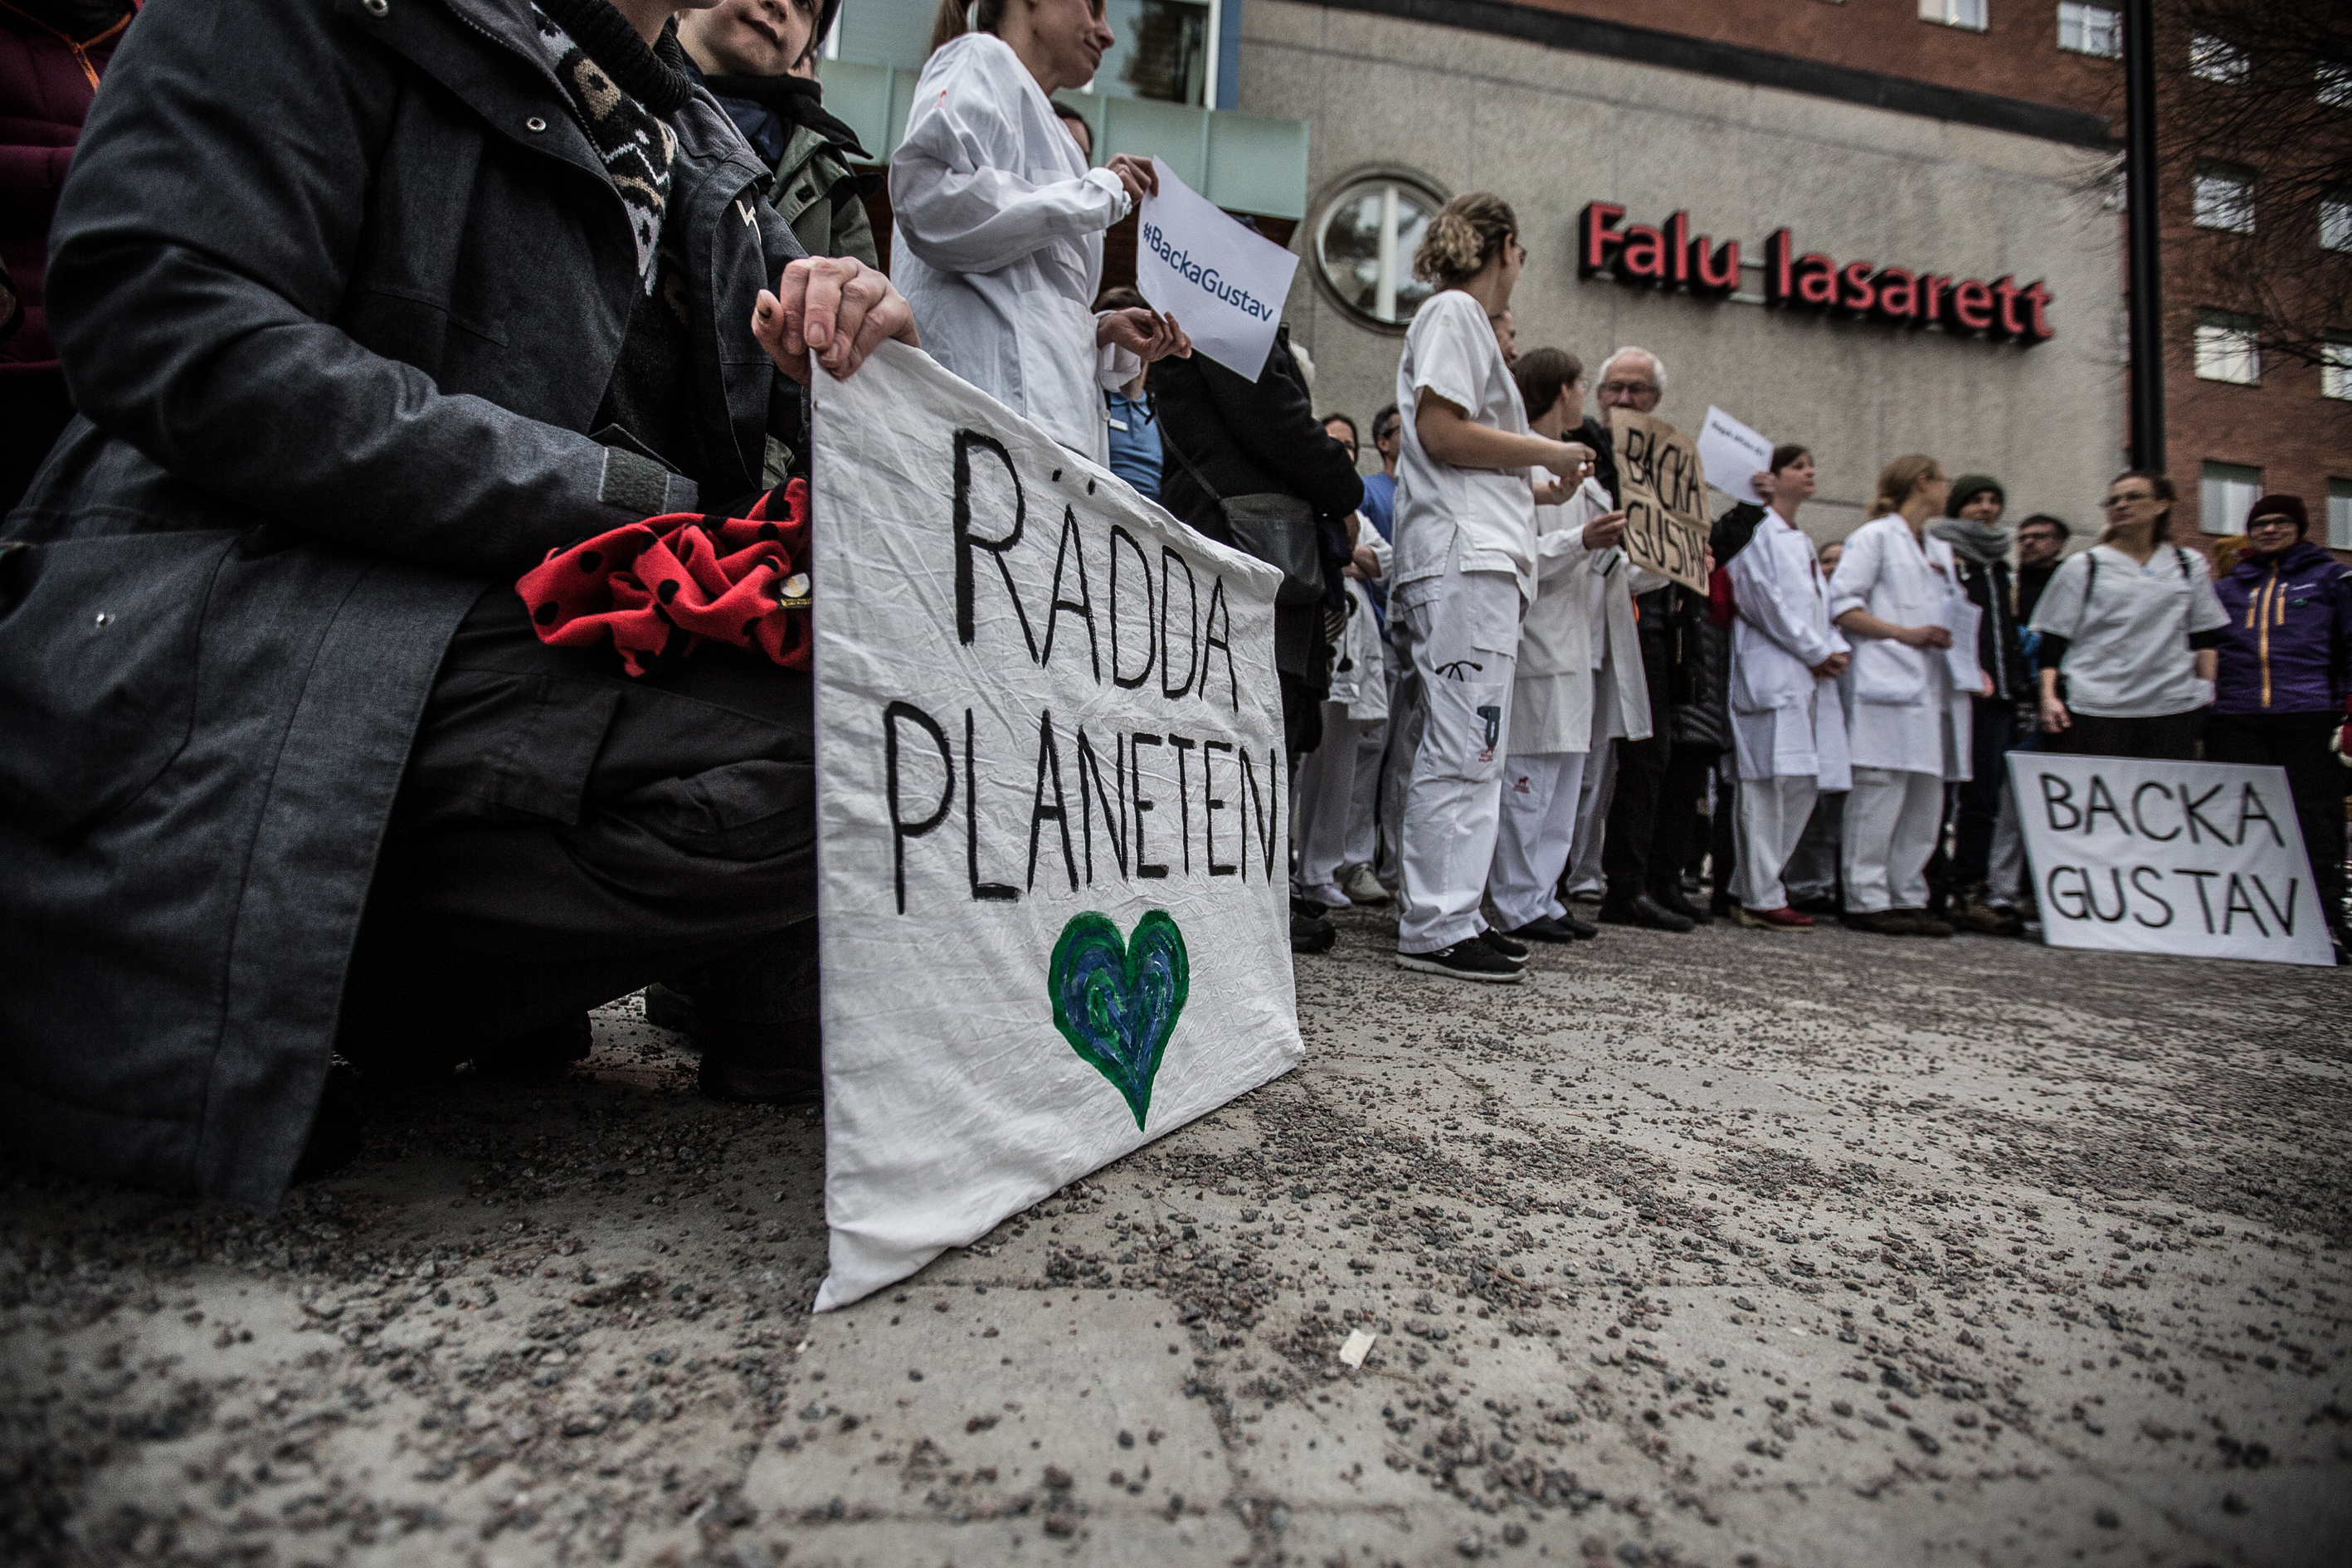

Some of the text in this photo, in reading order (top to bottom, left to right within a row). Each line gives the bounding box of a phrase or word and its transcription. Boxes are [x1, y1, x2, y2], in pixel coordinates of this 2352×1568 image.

[1143, 222, 1273, 322] #BackaGustav
[1581, 200, 2055, 340] Falu lasarett
[1625, 426, 1704, 521] BACKA
[952, 428, 1239, 714] RÄDDA
[1626, 499, 1707, 590] GUSTAV
[883, 700, 1278, 916] PLANETEN
[2038, 772, 2286, 848] BACKA
[2047, 864, 2299, 938] GUSTAV
